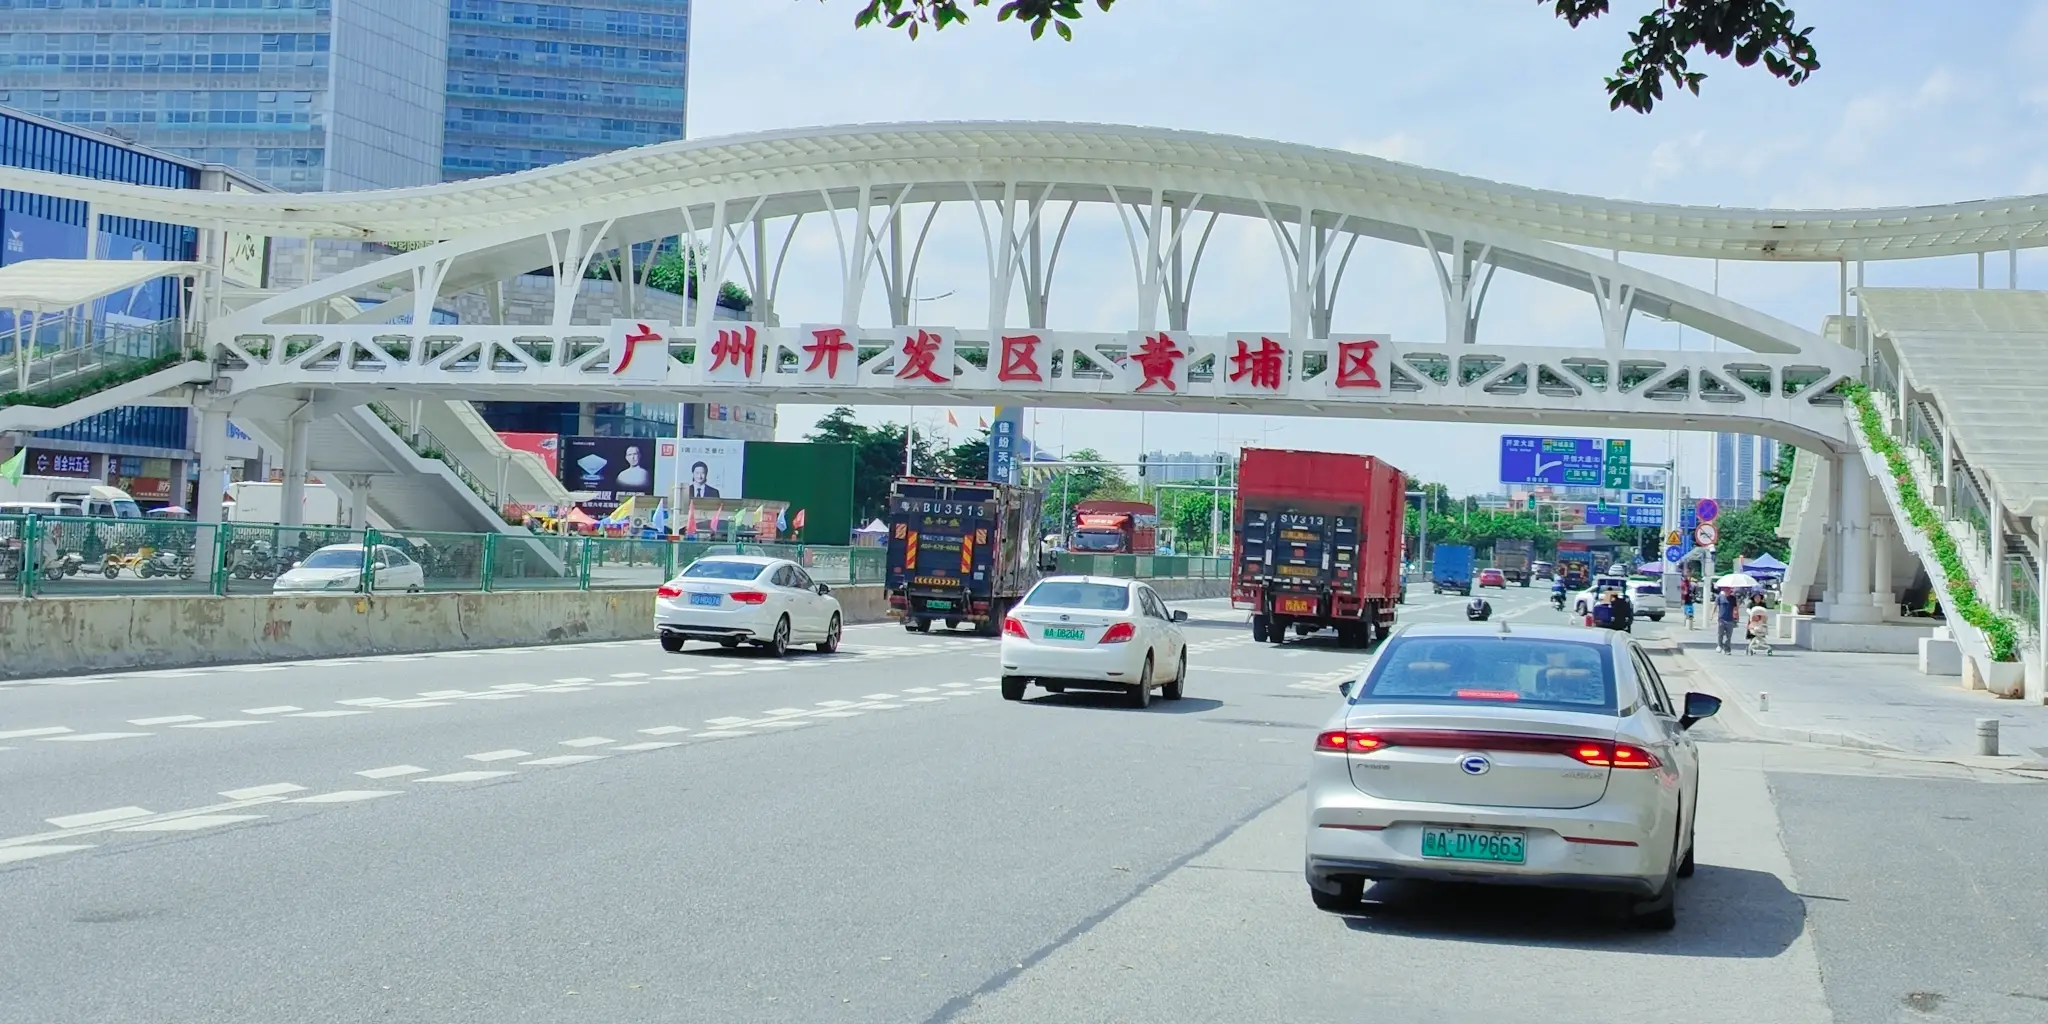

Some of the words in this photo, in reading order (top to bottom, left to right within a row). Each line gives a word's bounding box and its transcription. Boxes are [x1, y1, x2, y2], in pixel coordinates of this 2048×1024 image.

[612, 323, 1043, 383] 广州开发区
[1130, 332, 1382, 391] 黄埔区
[997, 422, 1009, 478] 佳纷天地
[54, 455, 90, 473] 创全兴五金
[1608, 455, 1628, 465] 广深
[1608, 466, 1628, 475] 沿江
